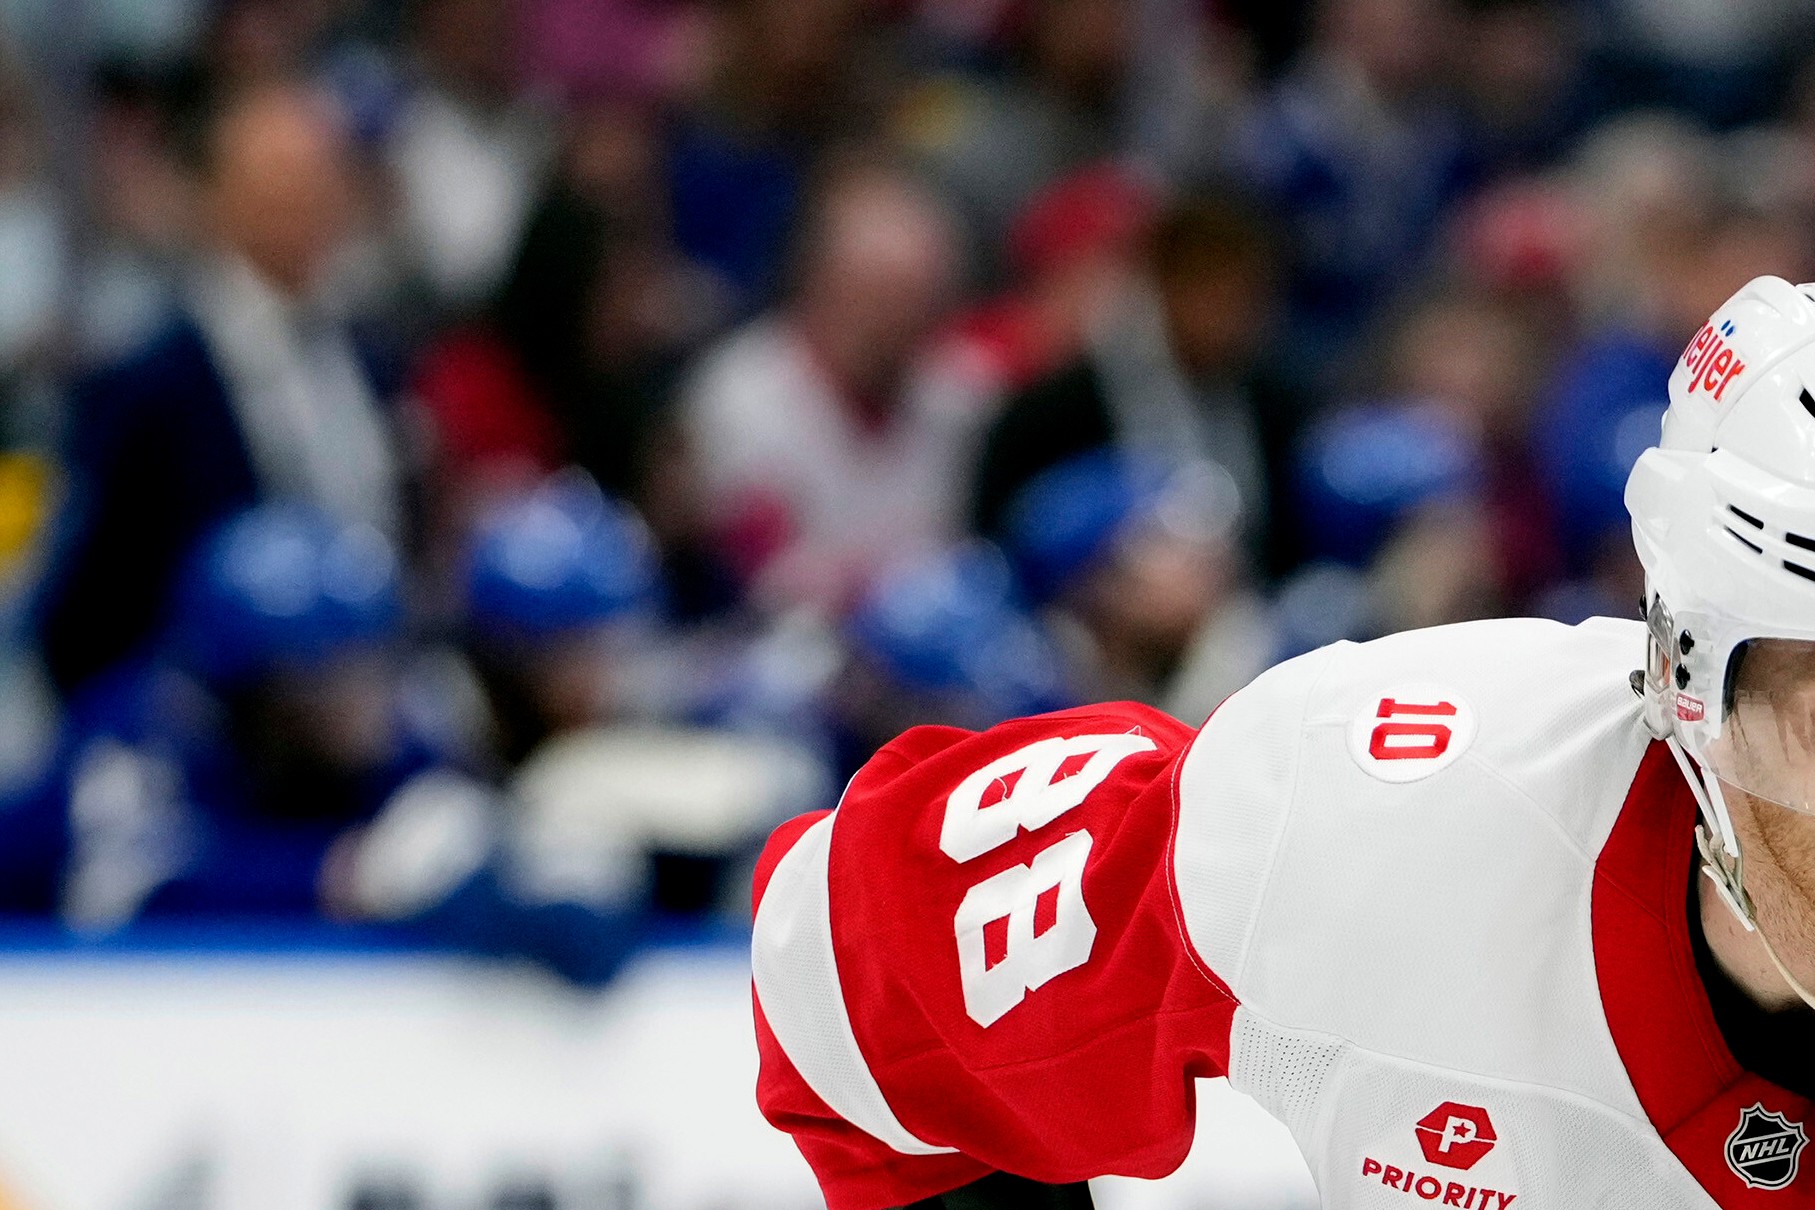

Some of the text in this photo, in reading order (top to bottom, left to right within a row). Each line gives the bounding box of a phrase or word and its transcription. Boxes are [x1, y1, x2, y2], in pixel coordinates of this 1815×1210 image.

[1682, 319, 1745, 401] eijer
[1369, 697, 1458, 760] 10
[939, 725, 1158, 1029] 88
[1739, 1137, 1790, 1162] NHL
